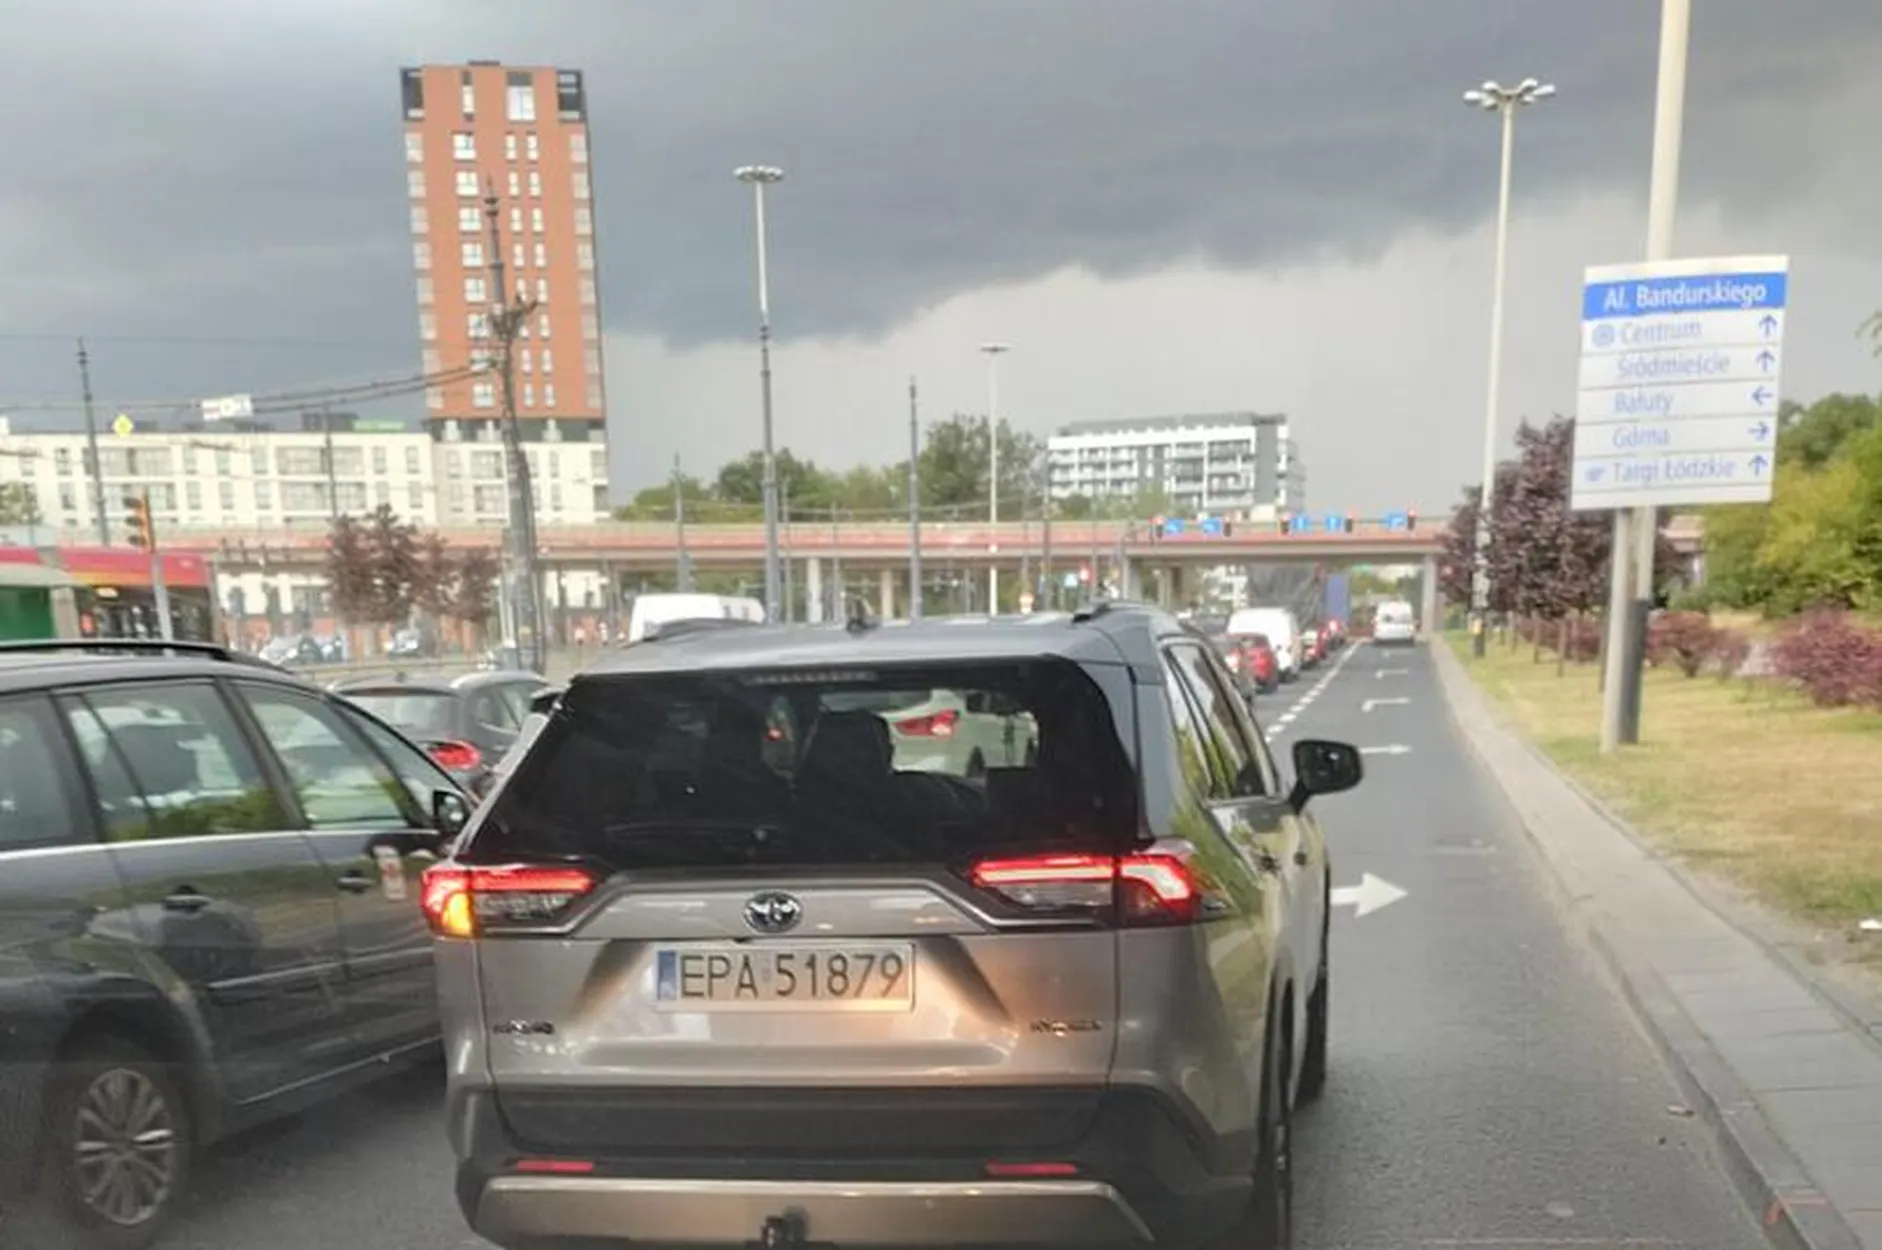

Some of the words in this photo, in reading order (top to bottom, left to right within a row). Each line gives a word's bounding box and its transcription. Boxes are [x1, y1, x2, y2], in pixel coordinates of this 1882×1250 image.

[1604, 288, 1629, 310] Al.
[1636, 280, 1767, 311] Bandurskiego
[1620, 320, 1702, 344] Centrum
[1617, 352, 1731, 378] Śródmieście
[1614, 389, 1674, 416] Bałuty
[1613, 460, 1659, 485] Targi
[1666, 458, 1737, 481] Łódzkie
[680, 953, 759, 1000] EPA
[775, 953, 905, 1000] 51879
